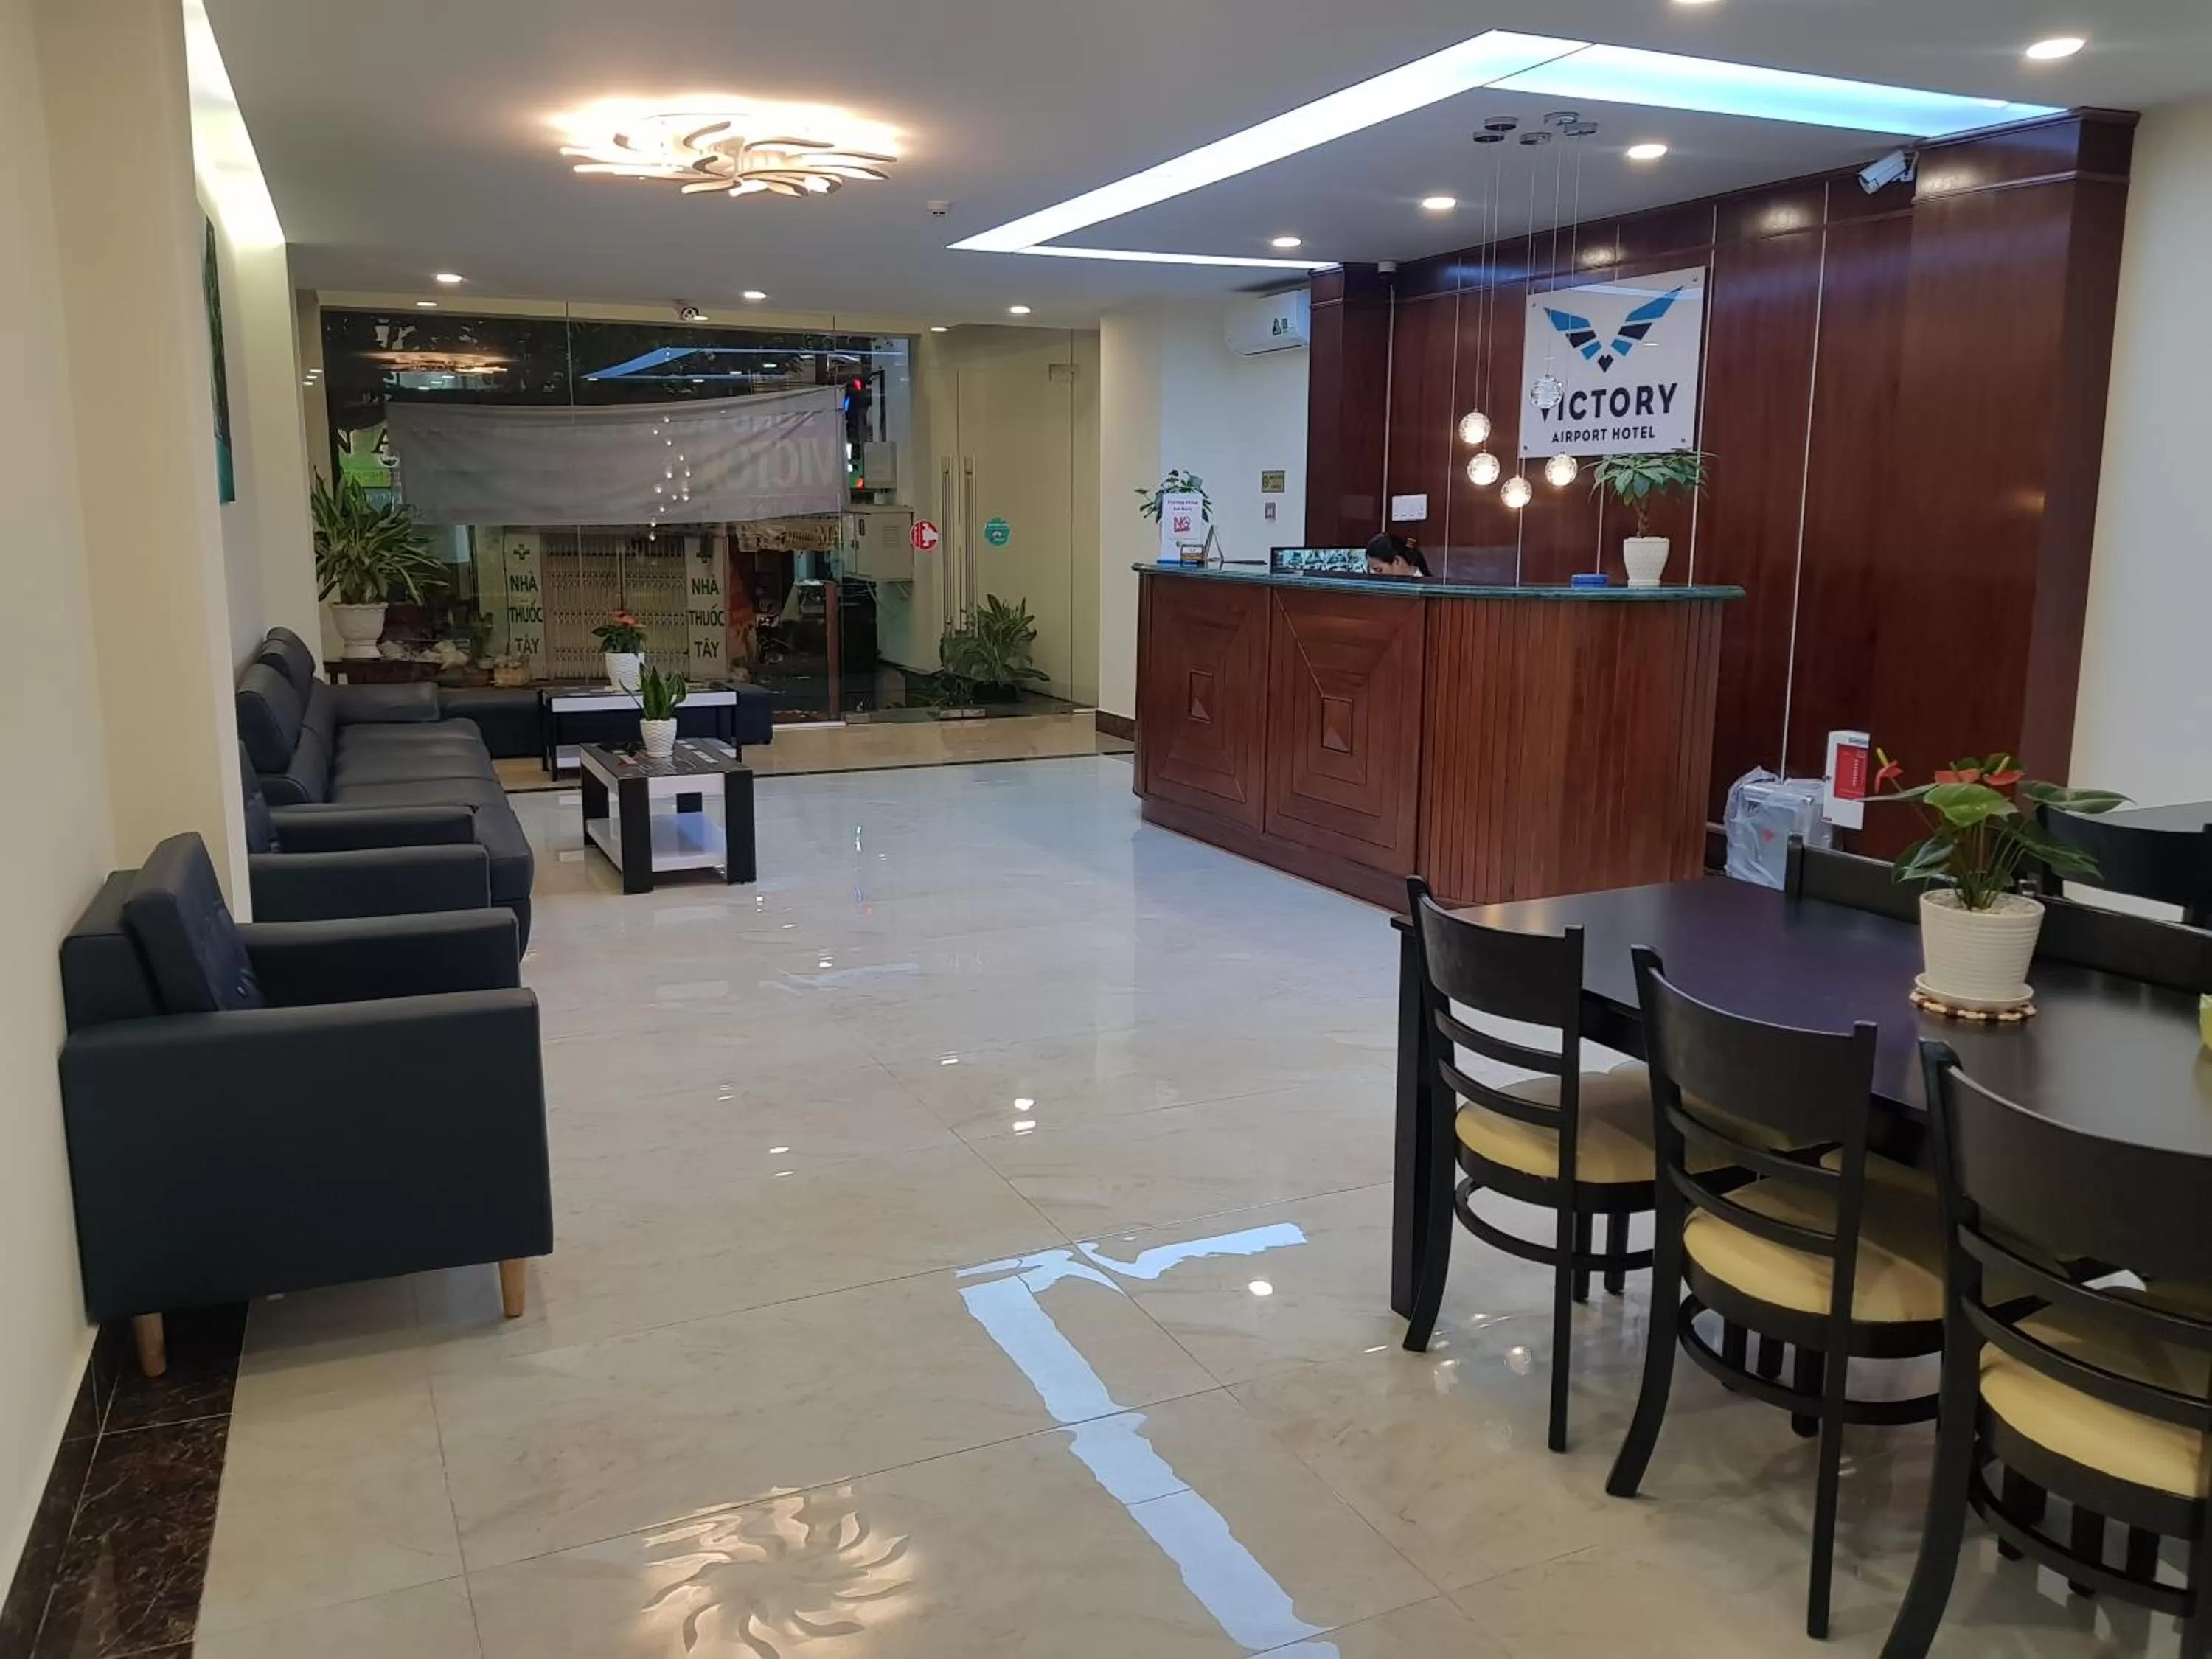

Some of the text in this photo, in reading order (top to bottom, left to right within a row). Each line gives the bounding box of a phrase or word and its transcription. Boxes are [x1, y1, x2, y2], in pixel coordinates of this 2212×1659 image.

[1551, 425, 1655, 443] AIRPORT HOTEL
[510, 570, 538, 592] NHÀ
[691, 574, 720, 595] NHÀ
[507, 599, 543, 623] THUỐC
[689, 604, 725, 627] THUỐC
[514, 633, 540, 655] TÂY
[694, 637, 720, 658] TÂY
